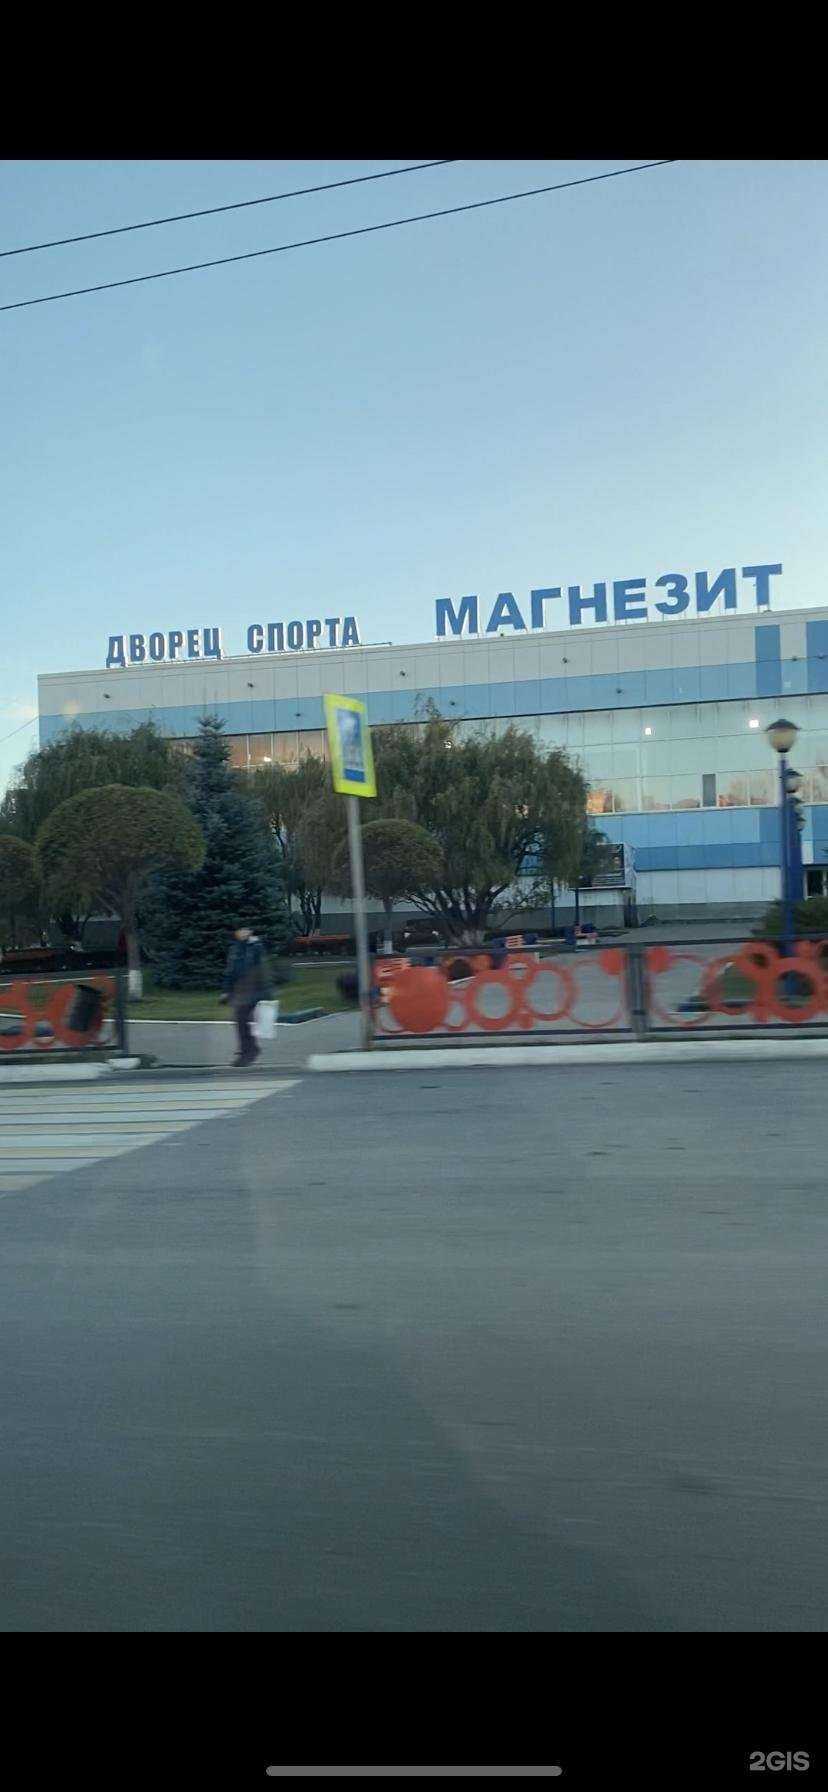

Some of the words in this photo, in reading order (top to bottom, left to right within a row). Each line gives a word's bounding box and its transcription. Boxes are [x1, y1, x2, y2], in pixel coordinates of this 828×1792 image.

[435, 563, 783, 636] МАГНЕЗИТ
[106, 627, 223, 668] ДВОРЕЦ
[247, 616, 360, 654] СПОРТА
